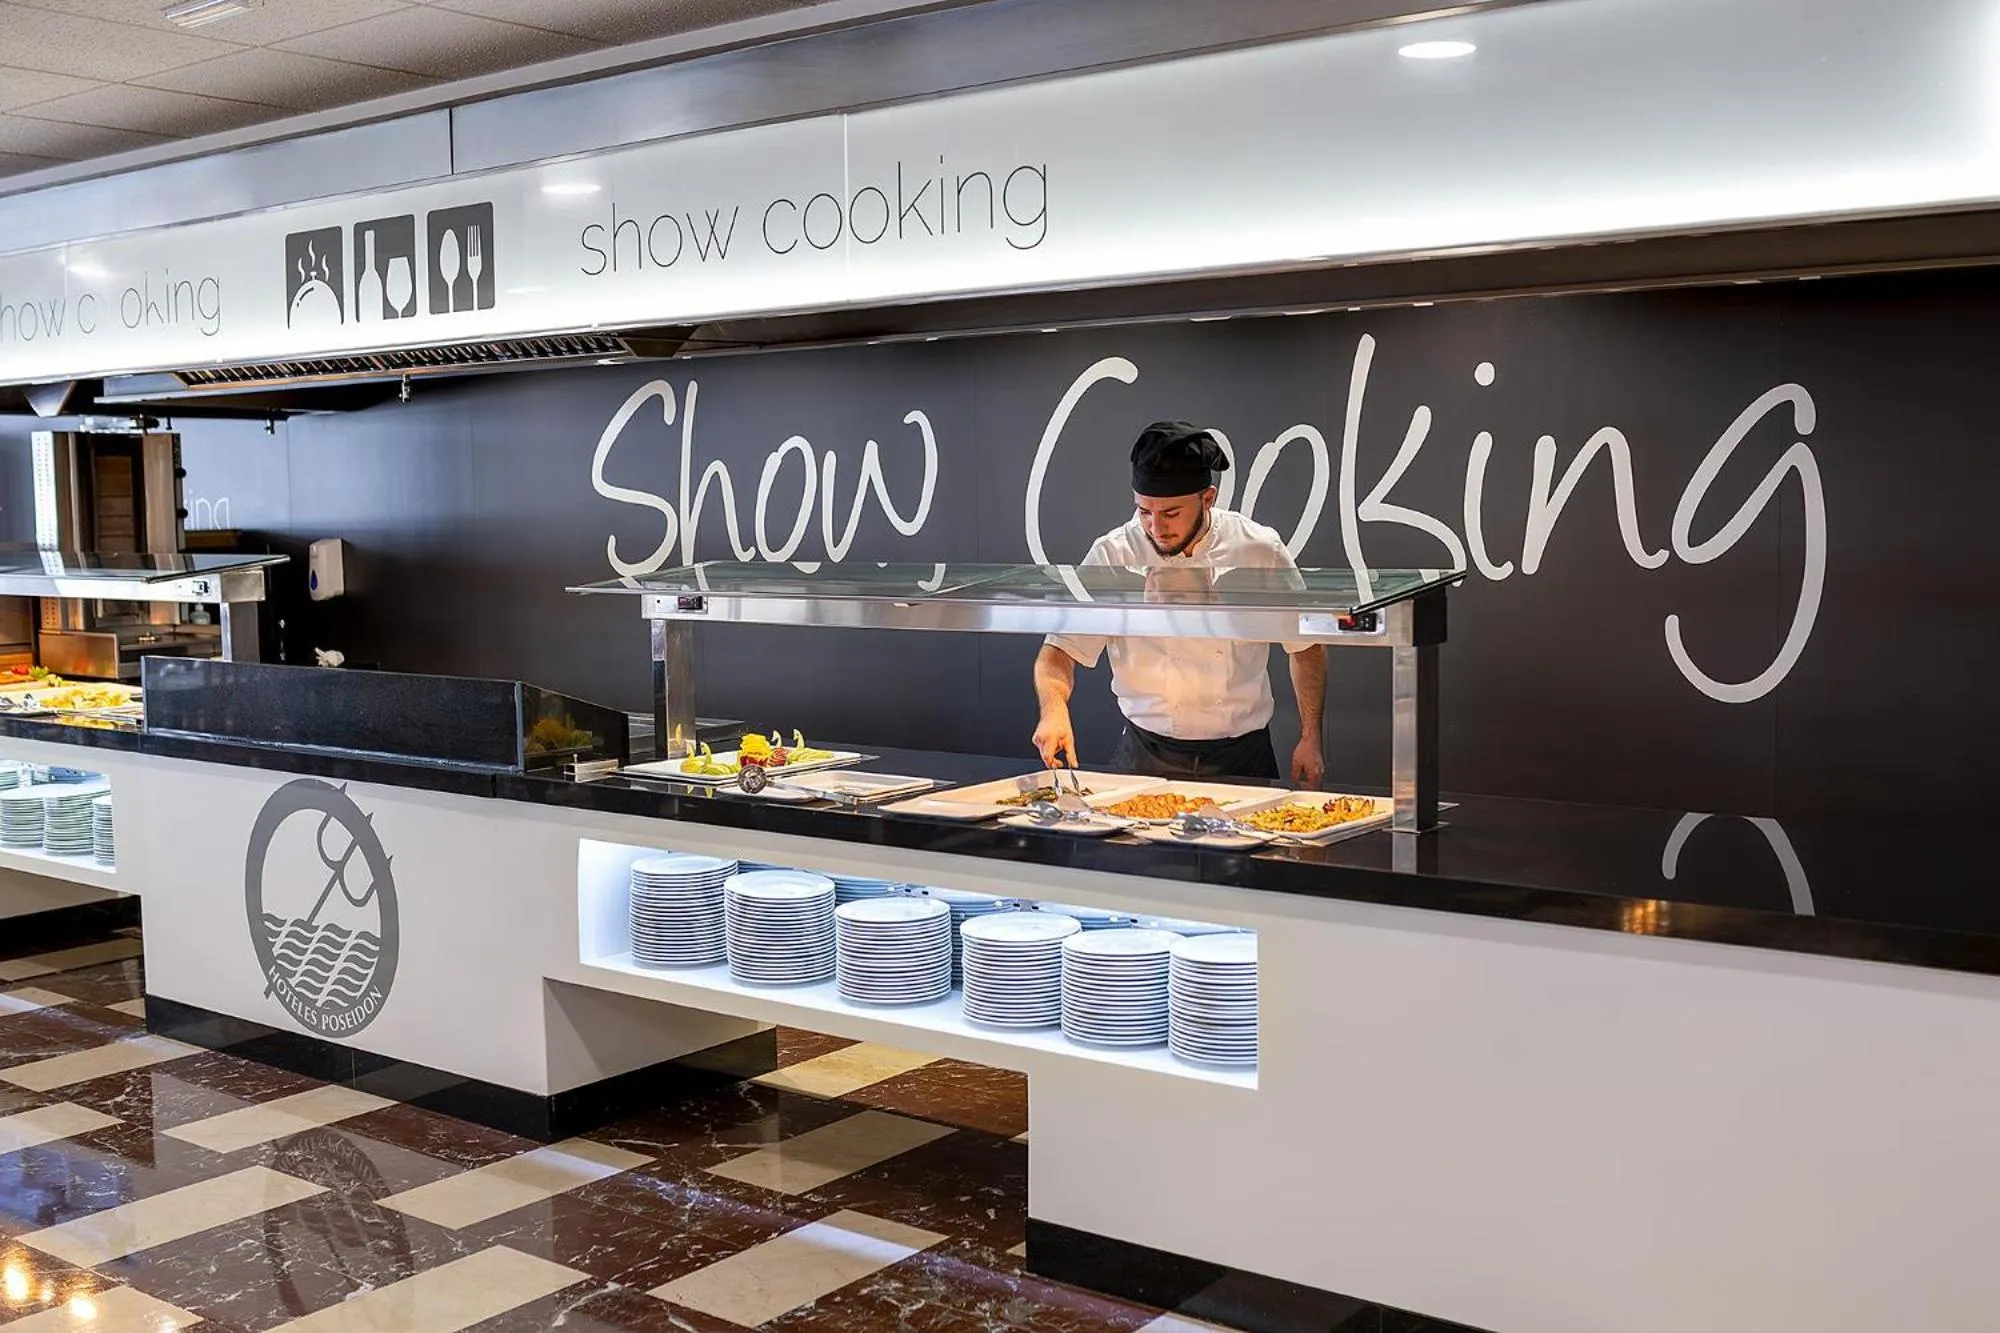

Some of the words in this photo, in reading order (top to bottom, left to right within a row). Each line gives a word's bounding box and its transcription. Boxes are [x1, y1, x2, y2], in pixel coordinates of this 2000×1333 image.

[580, 201, 740, 276] show
[762, 155, 1048, 250] cooking
[77, 268, 221, 337] coking
[591, 379, 939, 576] Show
[268, 964, 318, 1026] HOTELES
[321, 984, 383, 1032] POSEIDON
